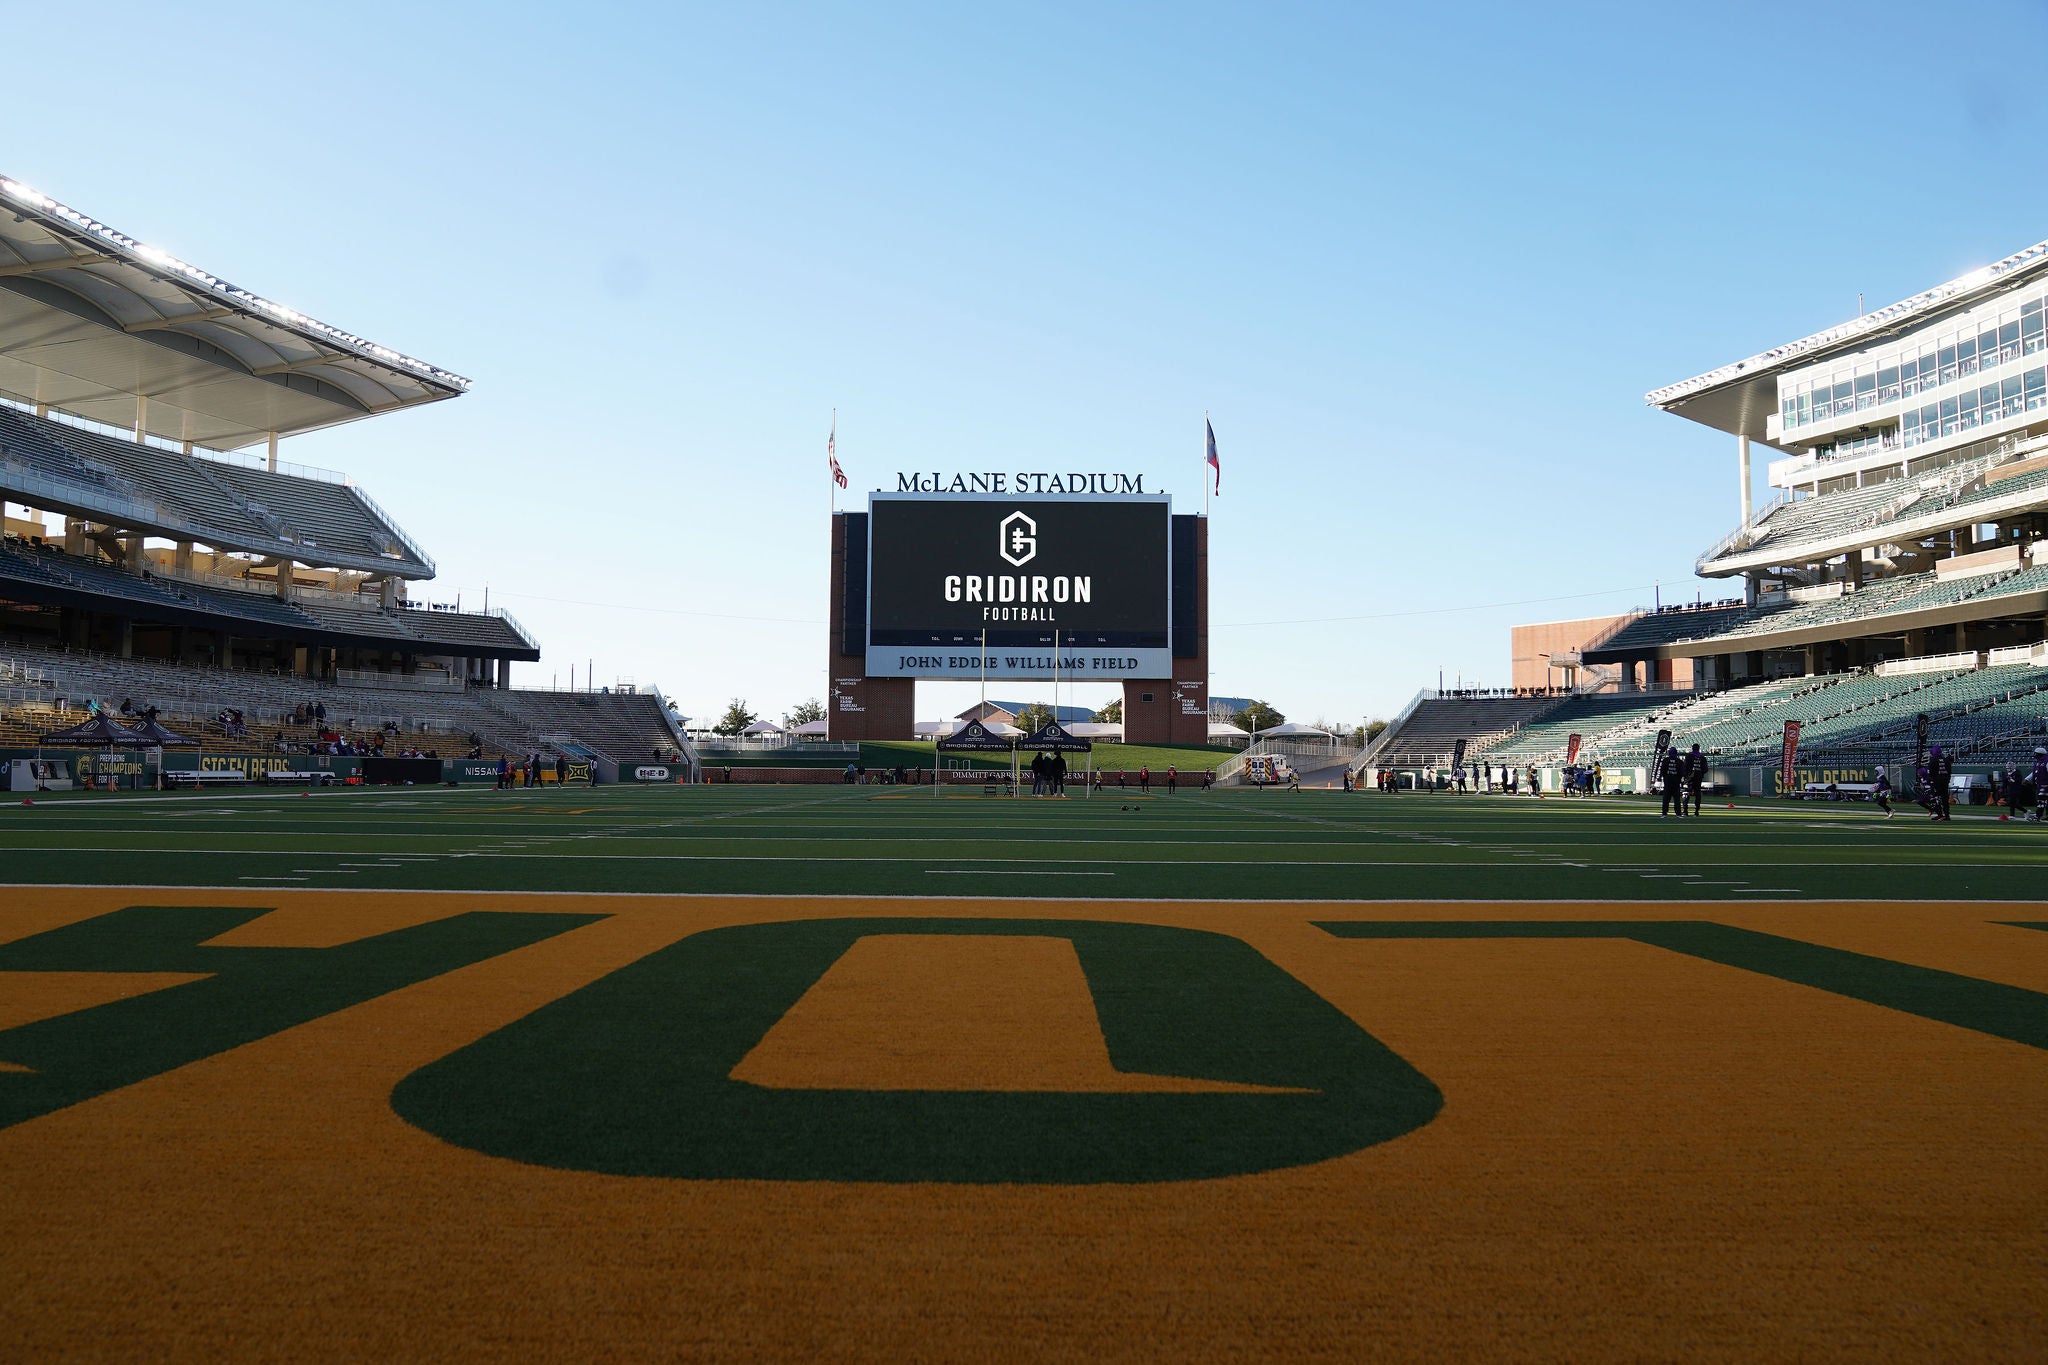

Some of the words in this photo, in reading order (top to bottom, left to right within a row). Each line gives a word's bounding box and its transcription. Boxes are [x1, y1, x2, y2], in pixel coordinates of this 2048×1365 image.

[897, 472, 1007, 493] McLANE
[1015, 472, 1144, 494] STADIUM
[944, 575, 1092, 602] GRIDIRON
[983, 608, 1056, 621] FOOTBALL
[900, 657, 942, 669] JOHN
[949, 657, 998, 668] EDDIE
[1005, 657, 1085, 669] WILLIAMS
[1092, 657, 1138, 669] FIELD
[465, 767, 498, 776] NISSAN
